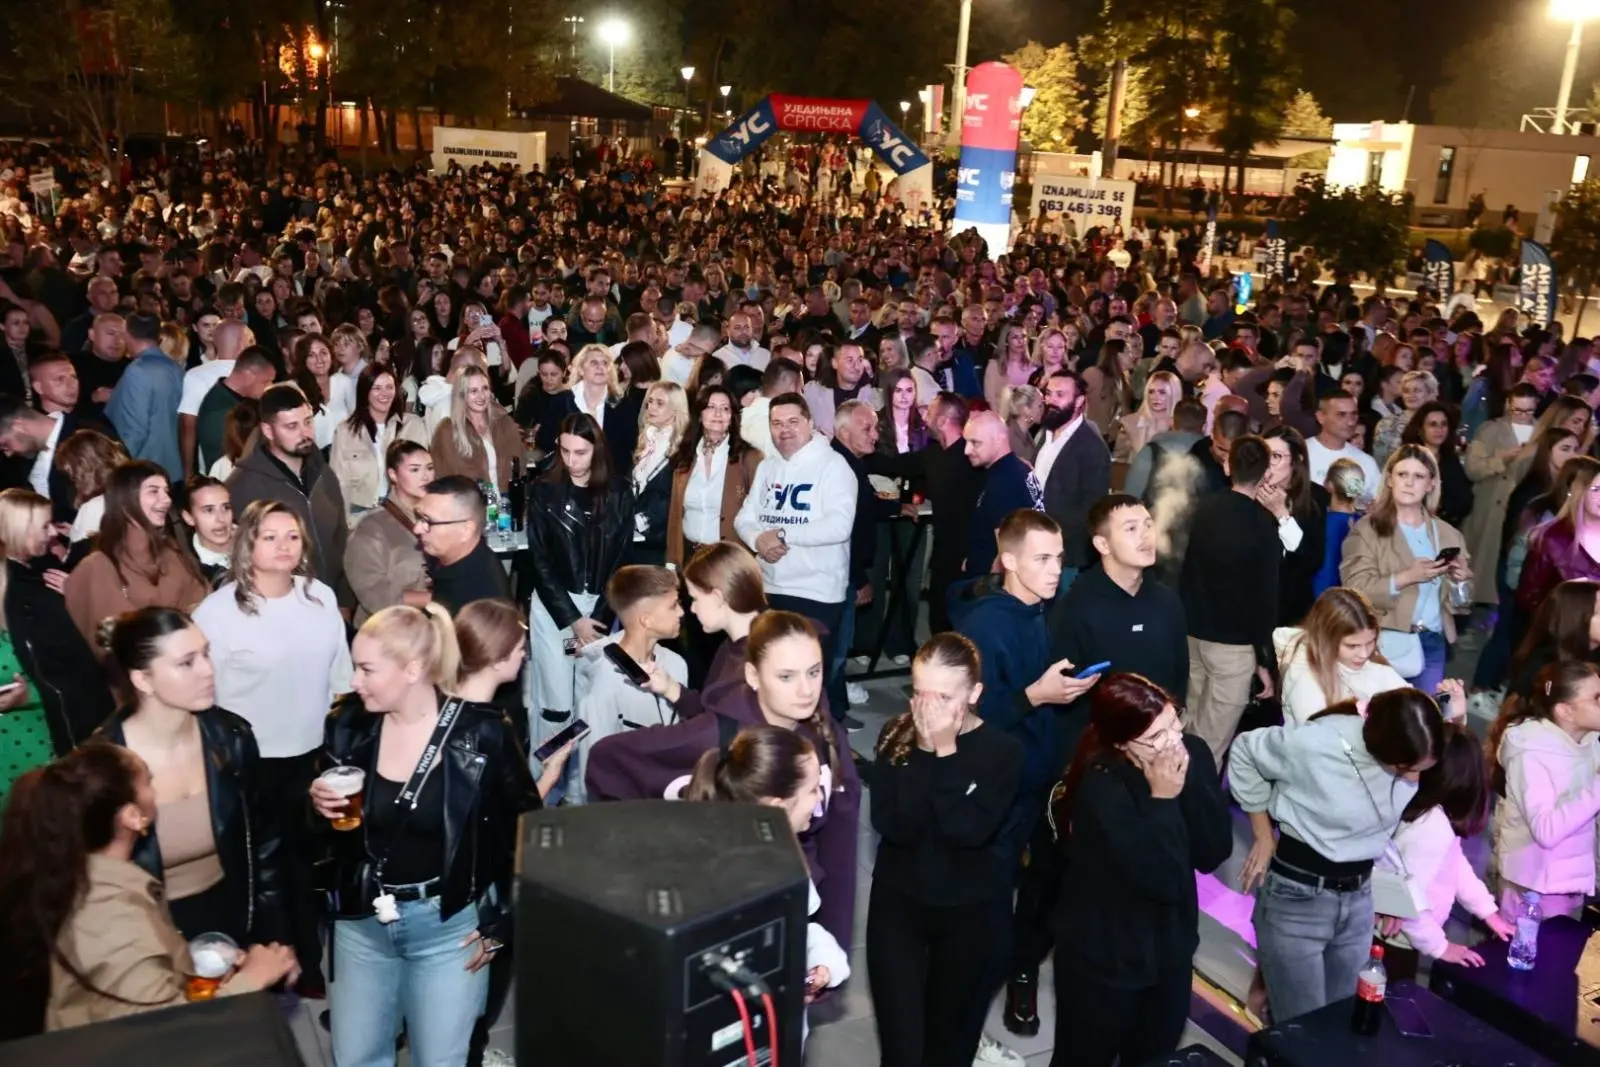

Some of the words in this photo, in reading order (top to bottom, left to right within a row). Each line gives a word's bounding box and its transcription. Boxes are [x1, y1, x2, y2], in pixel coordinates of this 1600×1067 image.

[783, 103, 853, 116] УЈЕДИЊЕНА
[783, 113, 852, 130] СРПСКА
[729, 111, 770, 144] УС
[879, 129, 915, 167] УС
[1042, 185, 1106, 200] IZNAJMLJUJE
[1112, 191, 1125, 202] SE
[1039, 199, 1064, 211] 063
[1096, 204, 1122, 217] 398
[775, 483, 814, 510] УС
[438, 701, 458, 727] MONA
[416, 744, 437, 774] MONA
